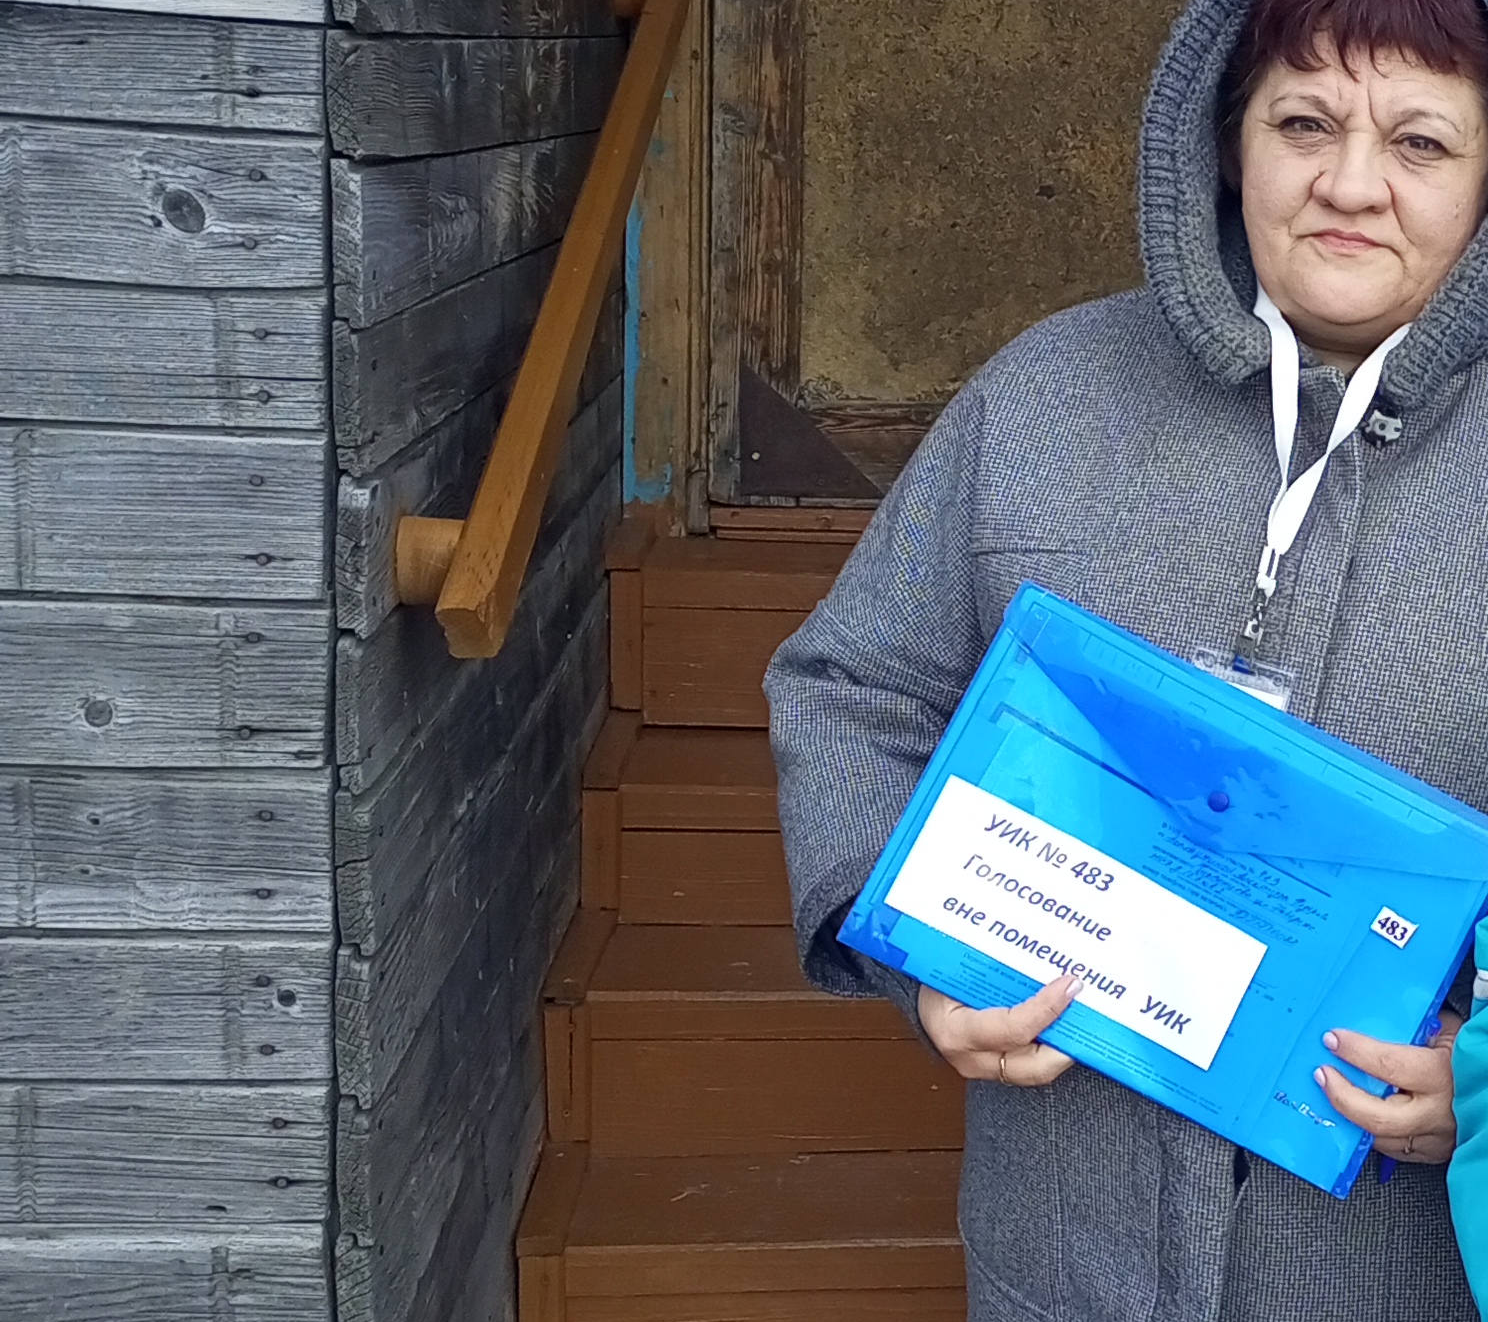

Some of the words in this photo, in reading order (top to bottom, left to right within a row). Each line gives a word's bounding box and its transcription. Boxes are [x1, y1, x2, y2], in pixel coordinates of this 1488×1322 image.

[984, 815, 1038, 853] УИК
[1037, 841, 1069, 871] №
[1070, 861, 1115, 893] 483
[963, 854, 1113, 943] Голосование
[1377, 916, 1409, 941] 483
[943, 897, 987, 927] вне
[988, 920, 1127, 999] помещения
[1139, 995, 1192, 1035] УИК
